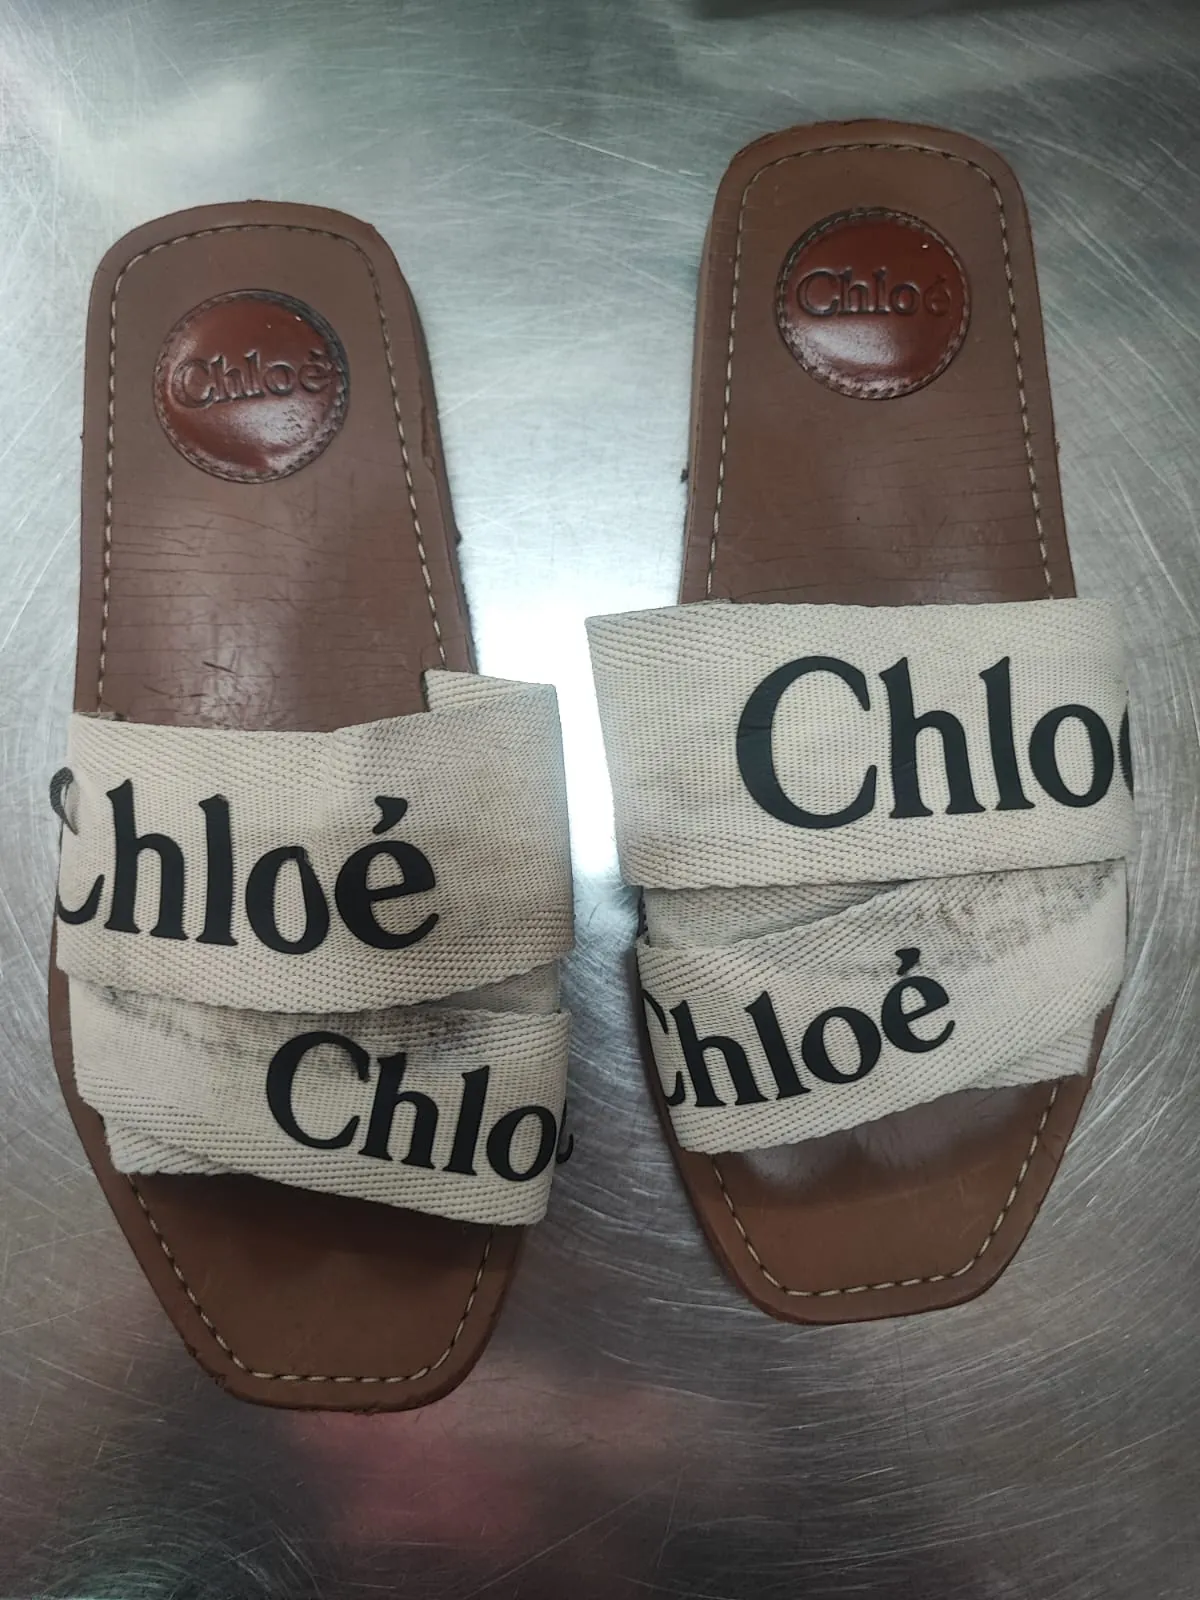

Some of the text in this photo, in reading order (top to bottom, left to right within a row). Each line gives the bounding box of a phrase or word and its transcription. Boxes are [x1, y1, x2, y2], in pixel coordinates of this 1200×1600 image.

[795, 266, 952, 318] Chloé
[171, 349, 333, 409] Chloé
[735, 655, 1135, 829] Chlo
